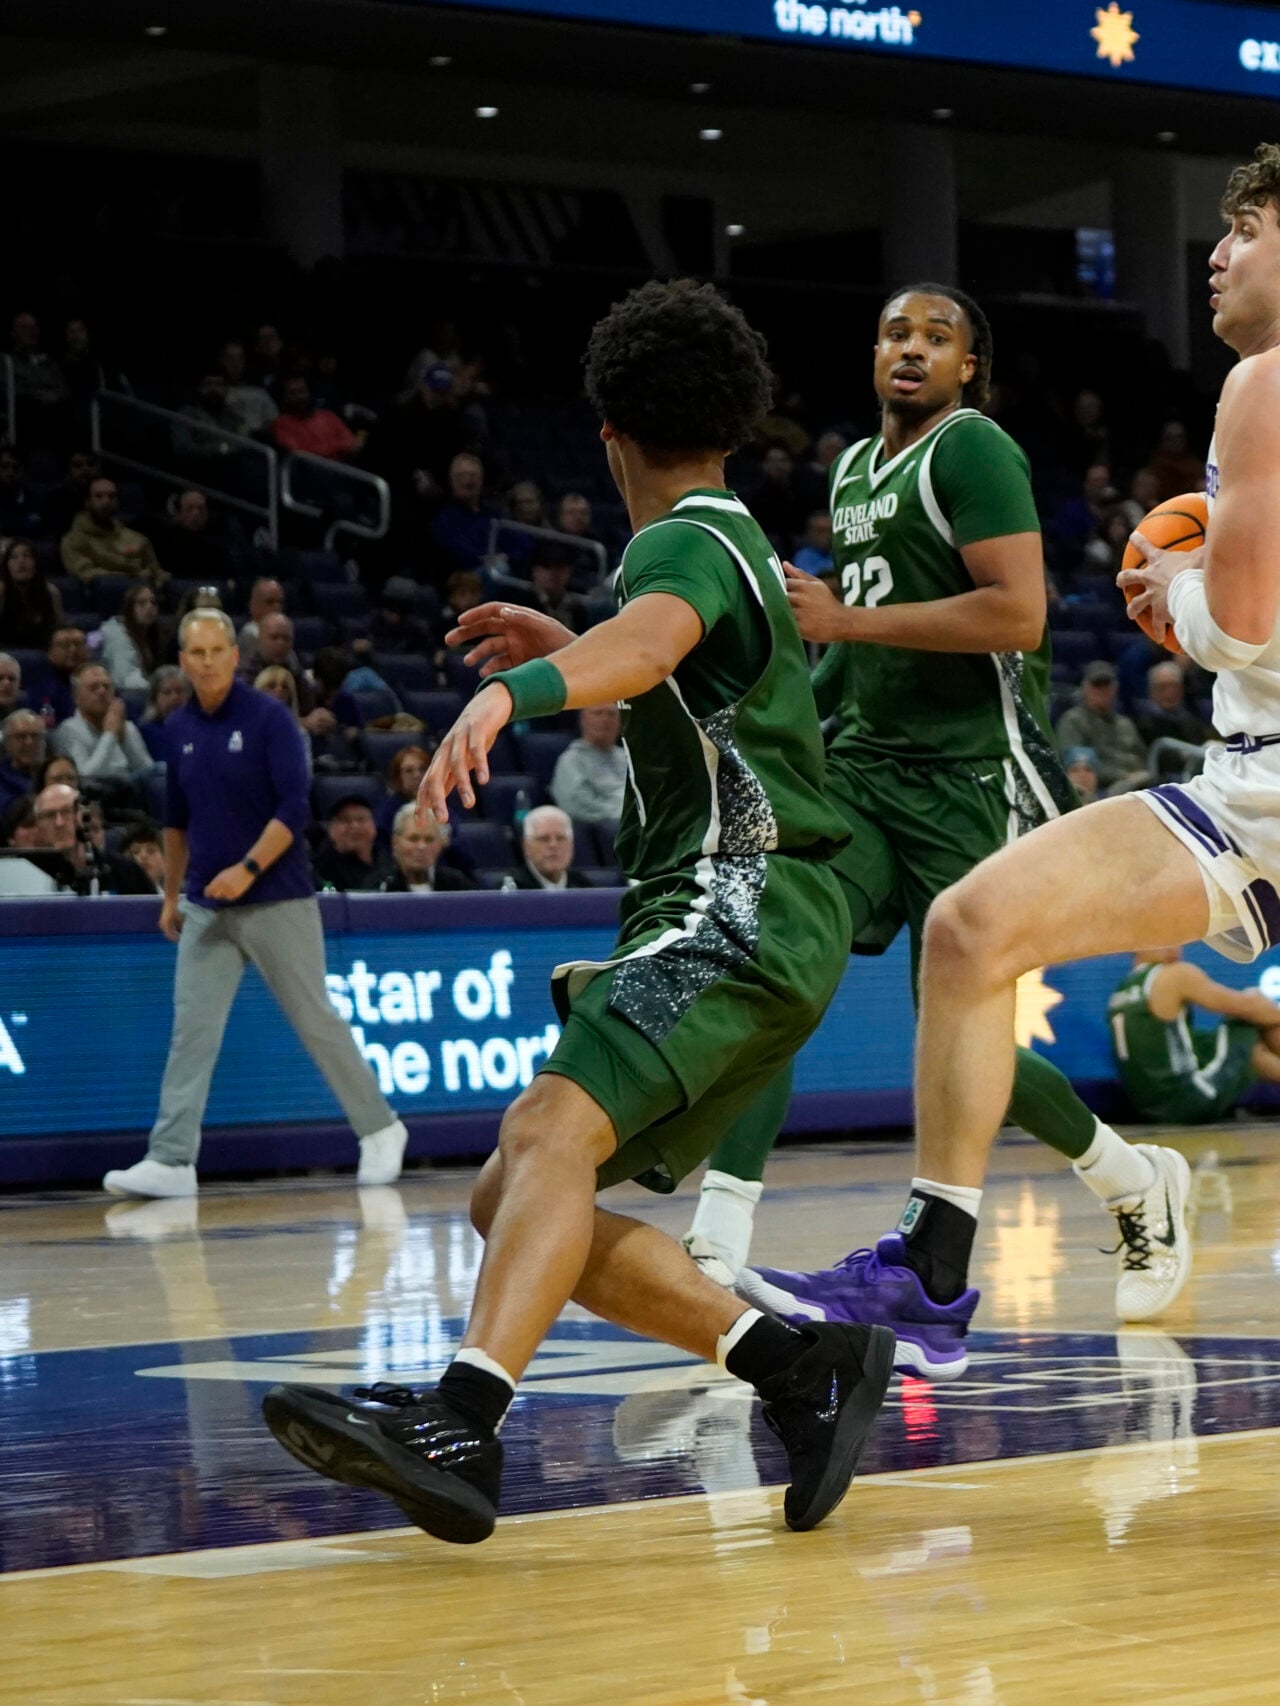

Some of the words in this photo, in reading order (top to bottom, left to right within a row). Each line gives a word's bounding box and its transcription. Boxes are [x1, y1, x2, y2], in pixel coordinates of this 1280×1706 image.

[773, 0, 828, 36] the
[829, 6, 914, 45] north
[832, 492, 898, 534] CLEVELAND
[844, 520, 876, 546] STATE
[324, 960, 442, 1024] star
[453, 949, 515, 1021] of
[350, 1025, 431, 1094] he
